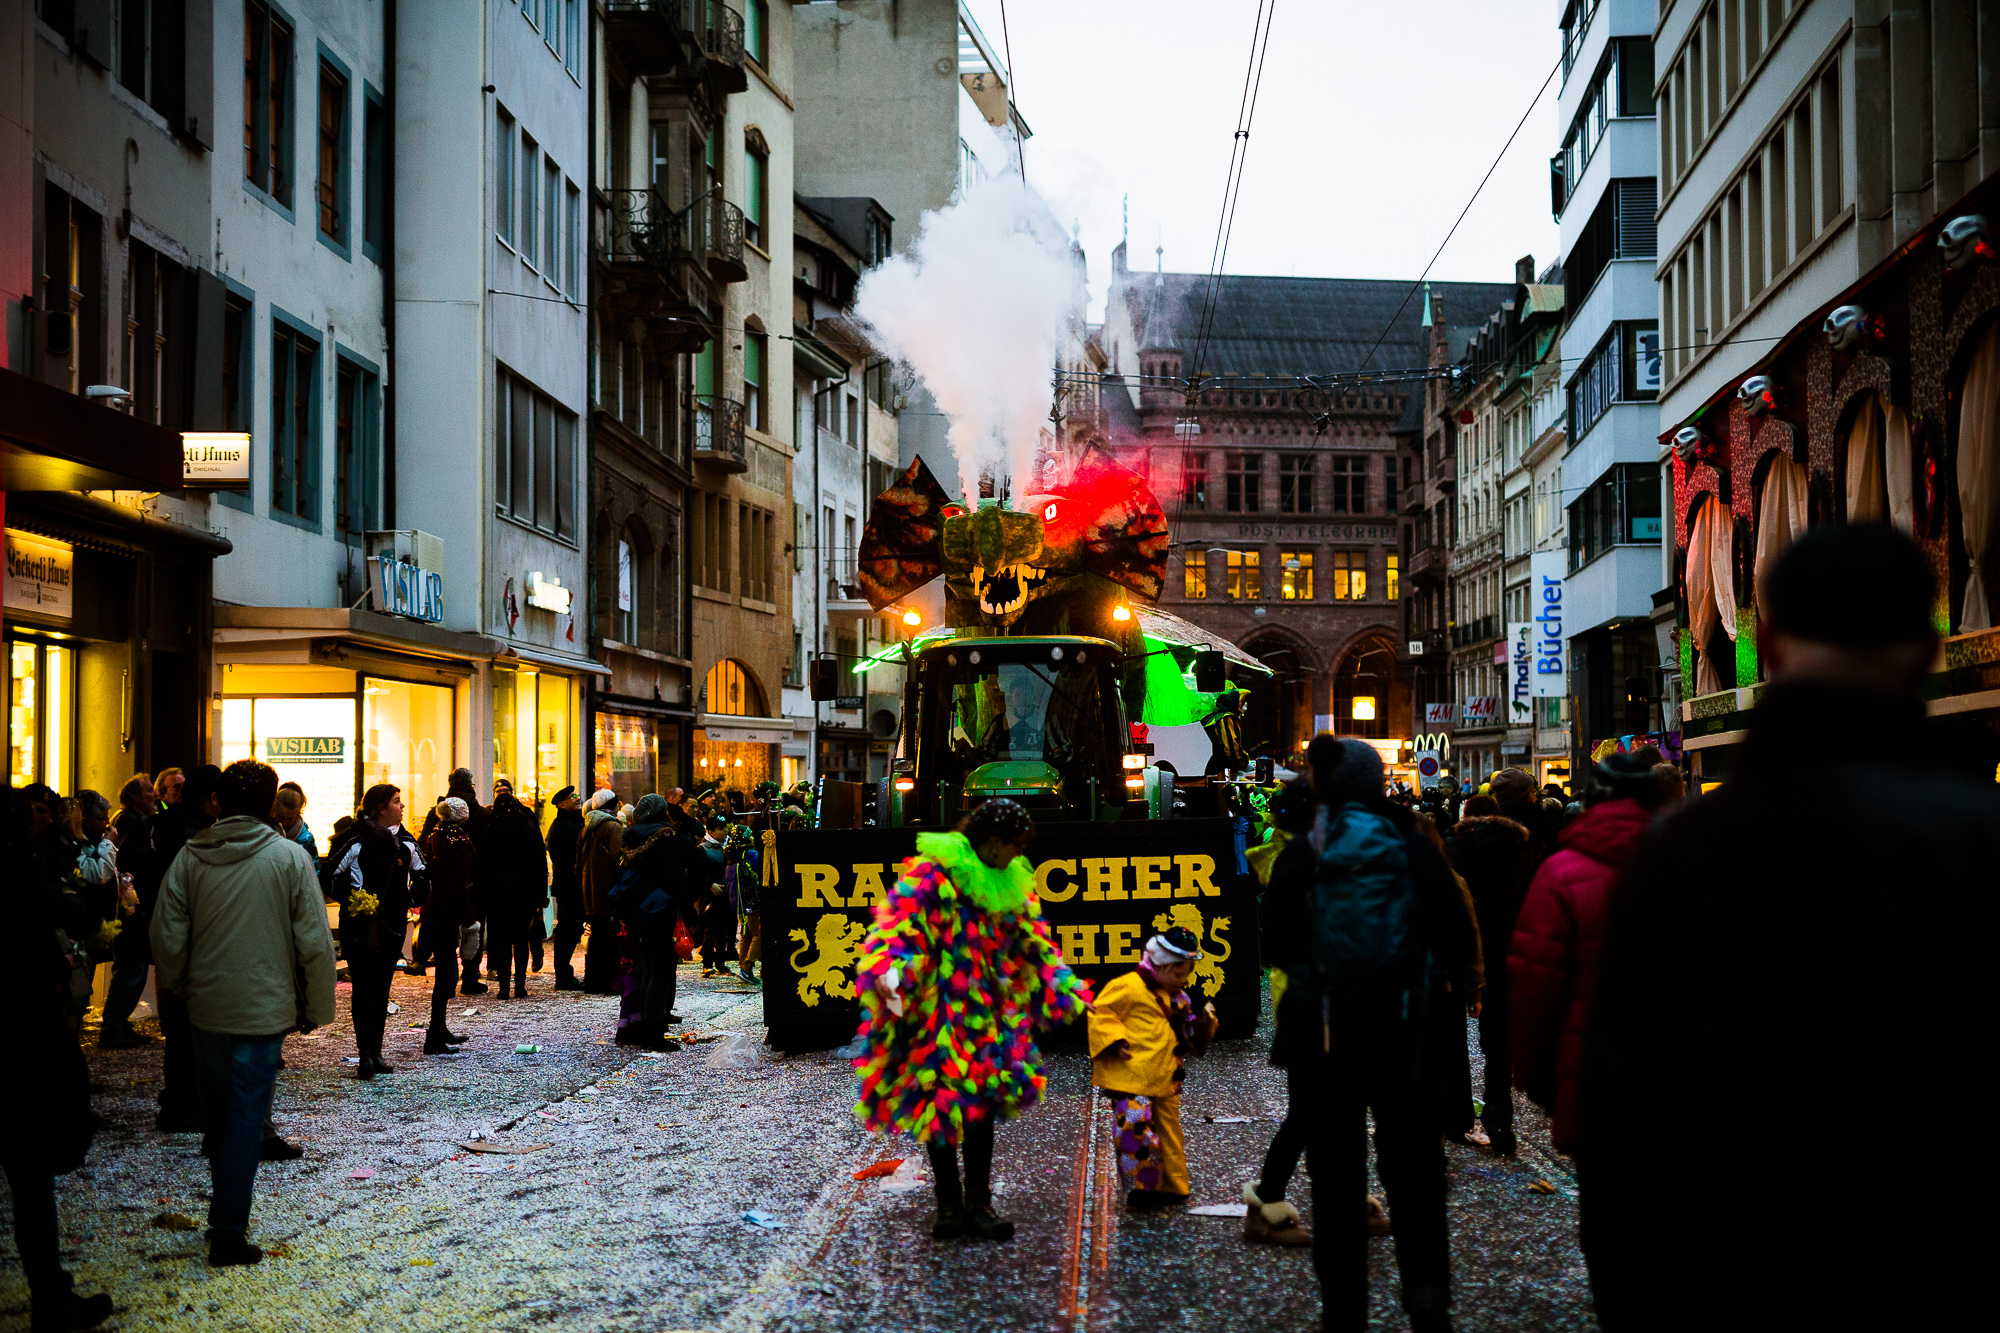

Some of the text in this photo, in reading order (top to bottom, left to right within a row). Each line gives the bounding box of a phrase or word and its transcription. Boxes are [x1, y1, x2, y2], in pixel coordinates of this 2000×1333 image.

[7, 545, 70, 586] Läckerli Huus
[378, 555, 444, 623] VISILAB
[1535, 575, 1563, 674] Bücher
[1412, 644, 1421, 652] 18
[1514, 641, 1529, 700] Thalia
[836, 697, 862, 706] CHRIST
[269, 738, 341, 754] VISILAB
